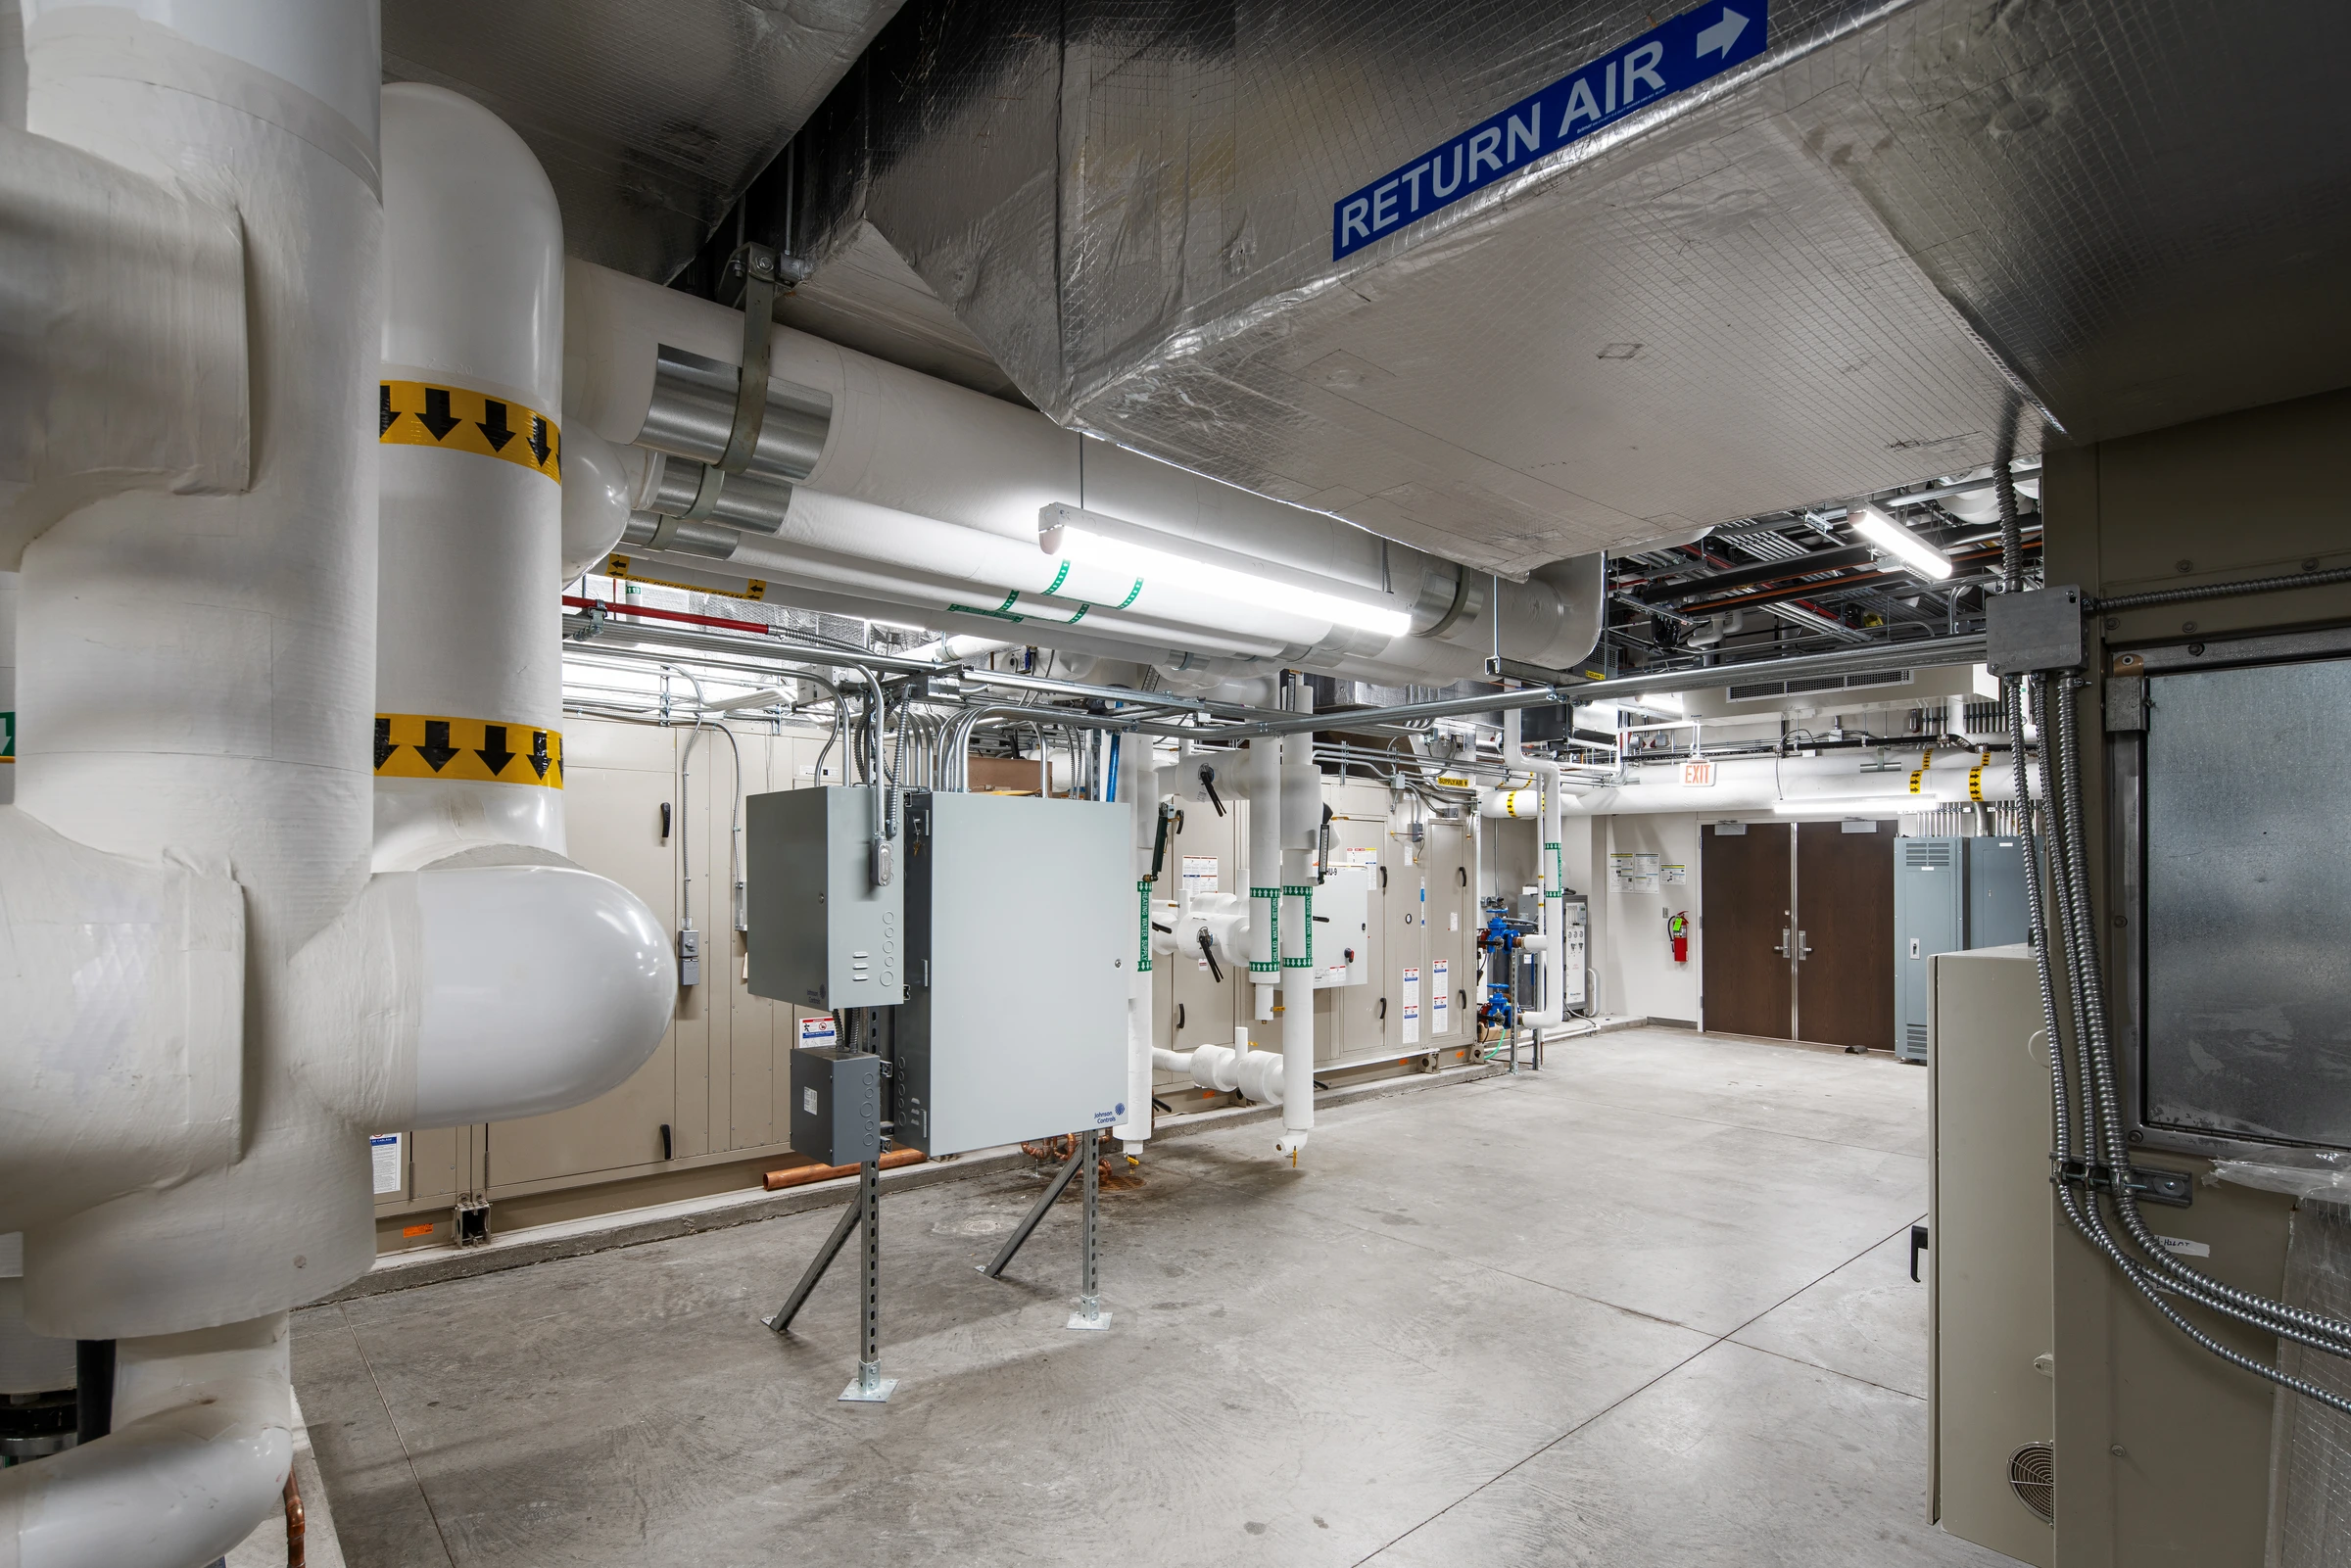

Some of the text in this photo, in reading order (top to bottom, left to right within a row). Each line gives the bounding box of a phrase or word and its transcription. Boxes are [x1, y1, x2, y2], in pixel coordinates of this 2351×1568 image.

[1341, 40, 1666, 247] RETURN AIR
[1685, 765, 1710, 784] EXIT
[1094, 1111, 1113, 1119] Johnson
[1097, 1116, 1116, 1124] Controls
